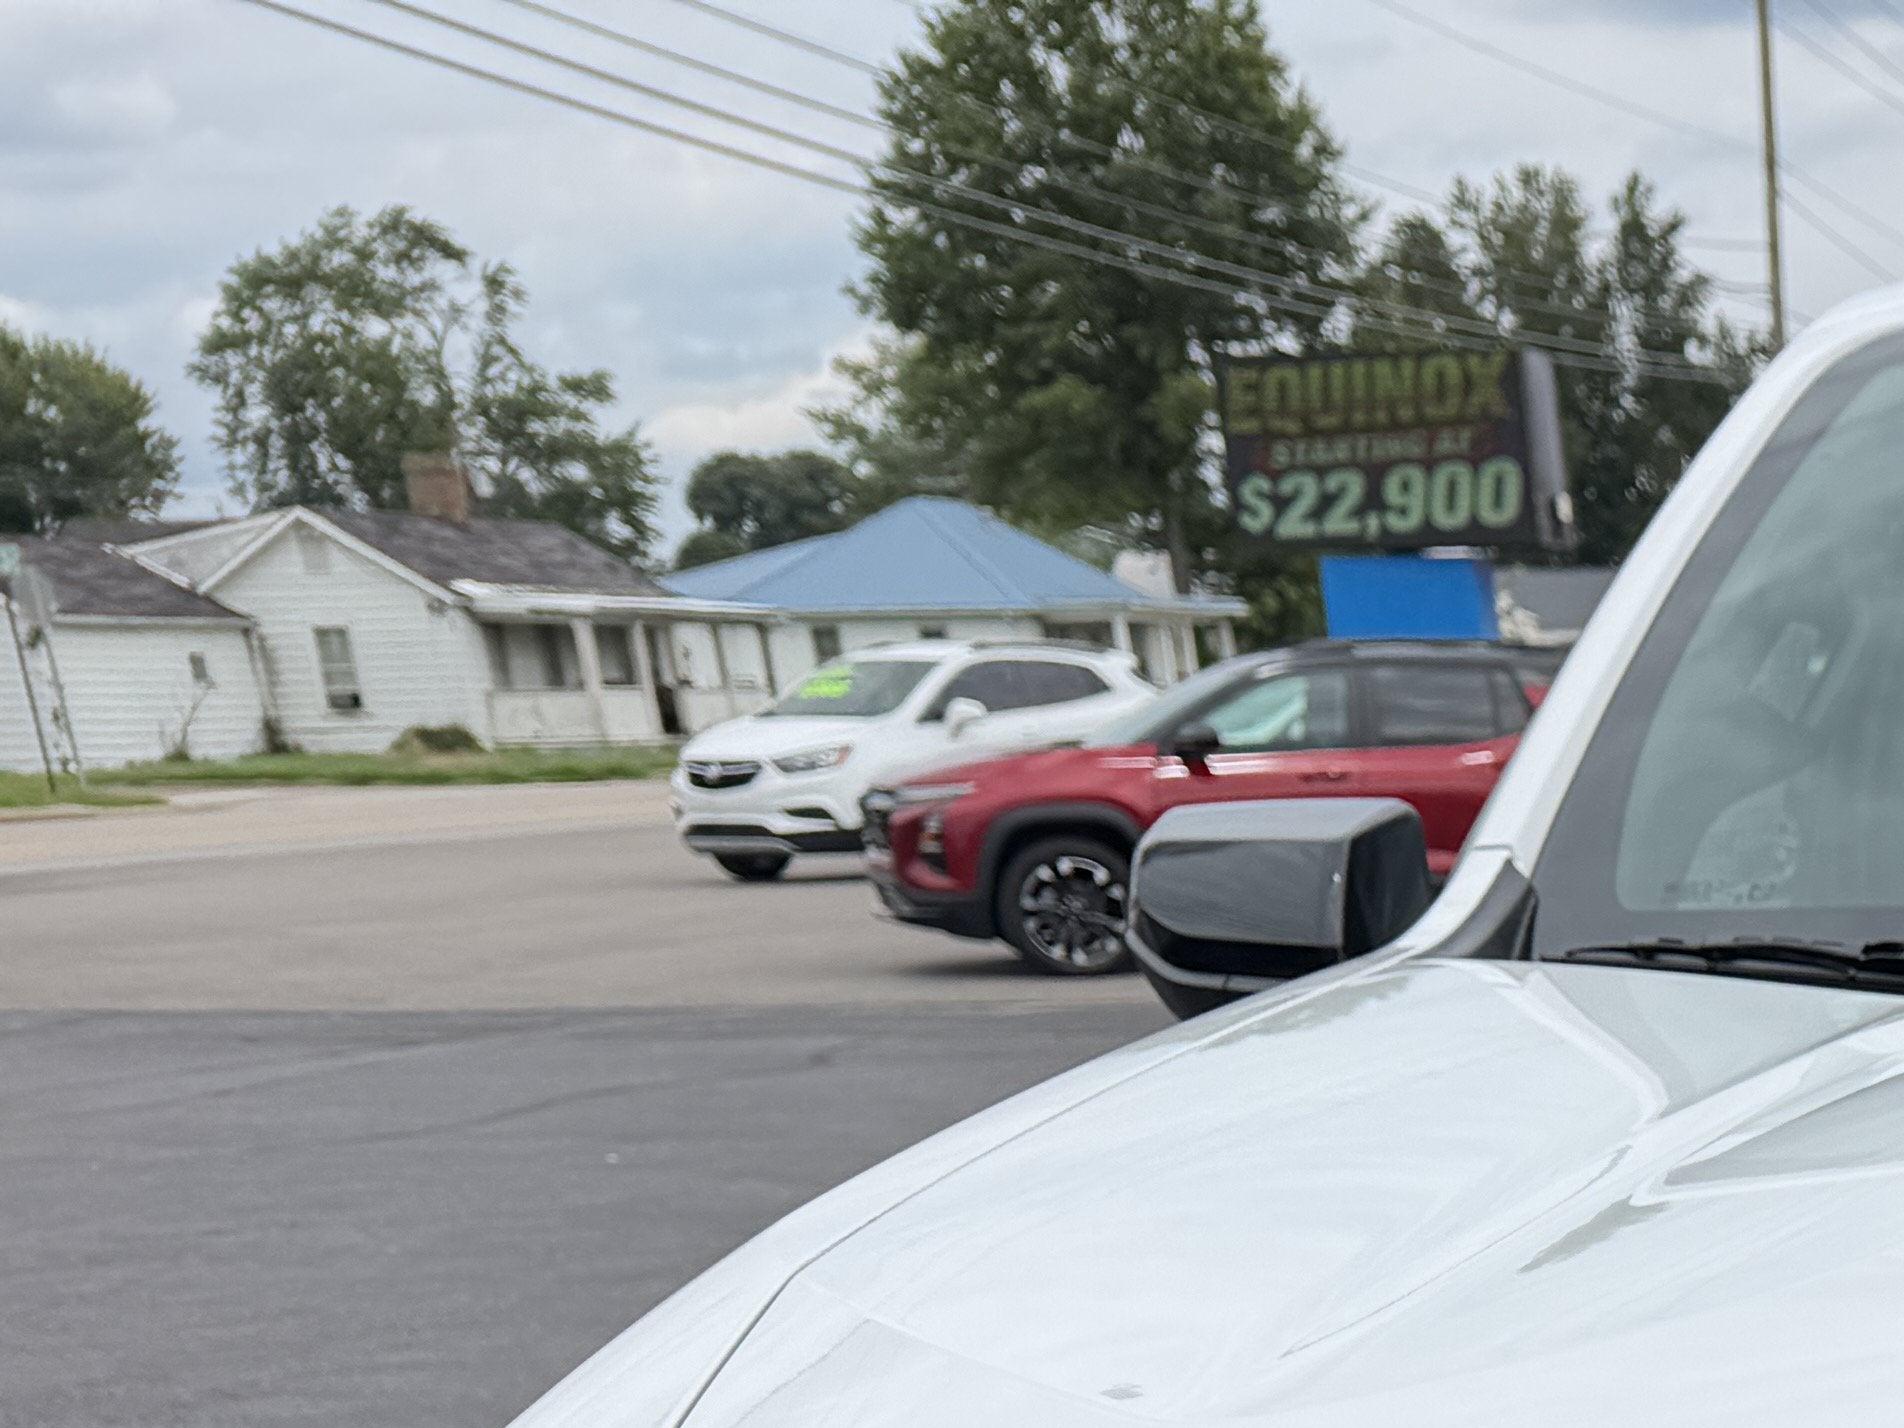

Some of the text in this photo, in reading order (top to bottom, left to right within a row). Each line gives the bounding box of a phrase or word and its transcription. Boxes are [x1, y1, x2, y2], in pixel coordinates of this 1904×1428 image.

[1228, 354, 1508, 433] EQUINOX
[1271, 430, 1473, 465] STARTING AT
[1239, 457, 1523, 540] $22,900
